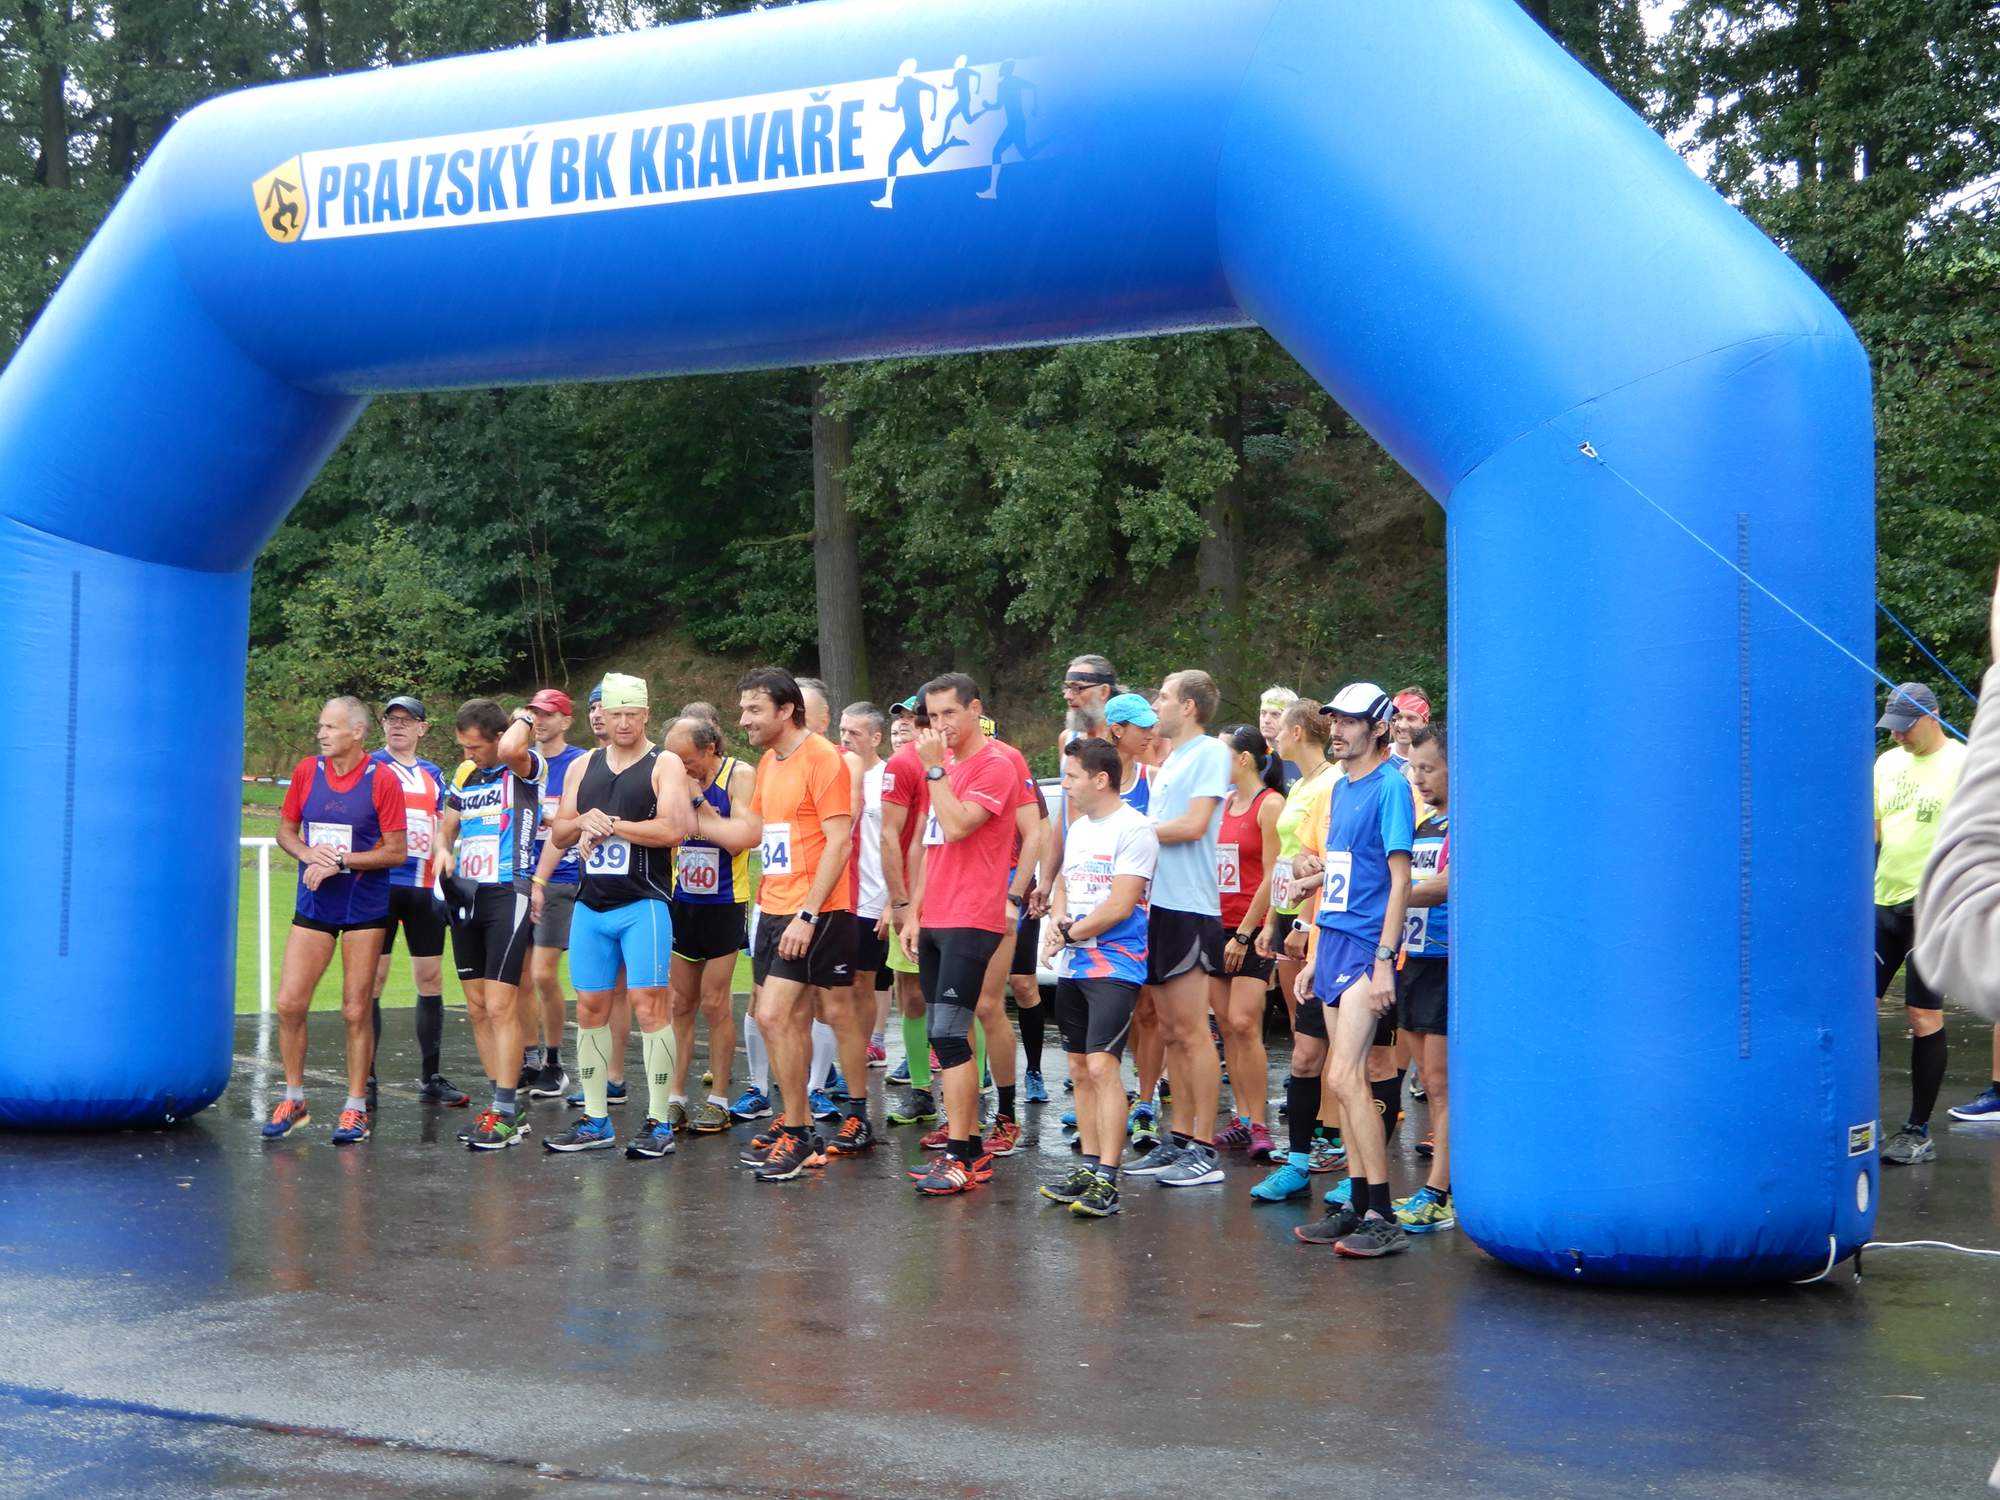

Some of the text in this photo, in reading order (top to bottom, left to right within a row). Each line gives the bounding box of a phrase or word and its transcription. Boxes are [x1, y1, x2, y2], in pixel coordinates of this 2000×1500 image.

[318, 90, 865, 228] PRAJZSKÝ BK KRAVAŘE
[463, 854, 493, 878] 101
[589, 843, 627, 868] 39
[762, 842, 788, 868] 34
[681, 864, 717, 888] 140
